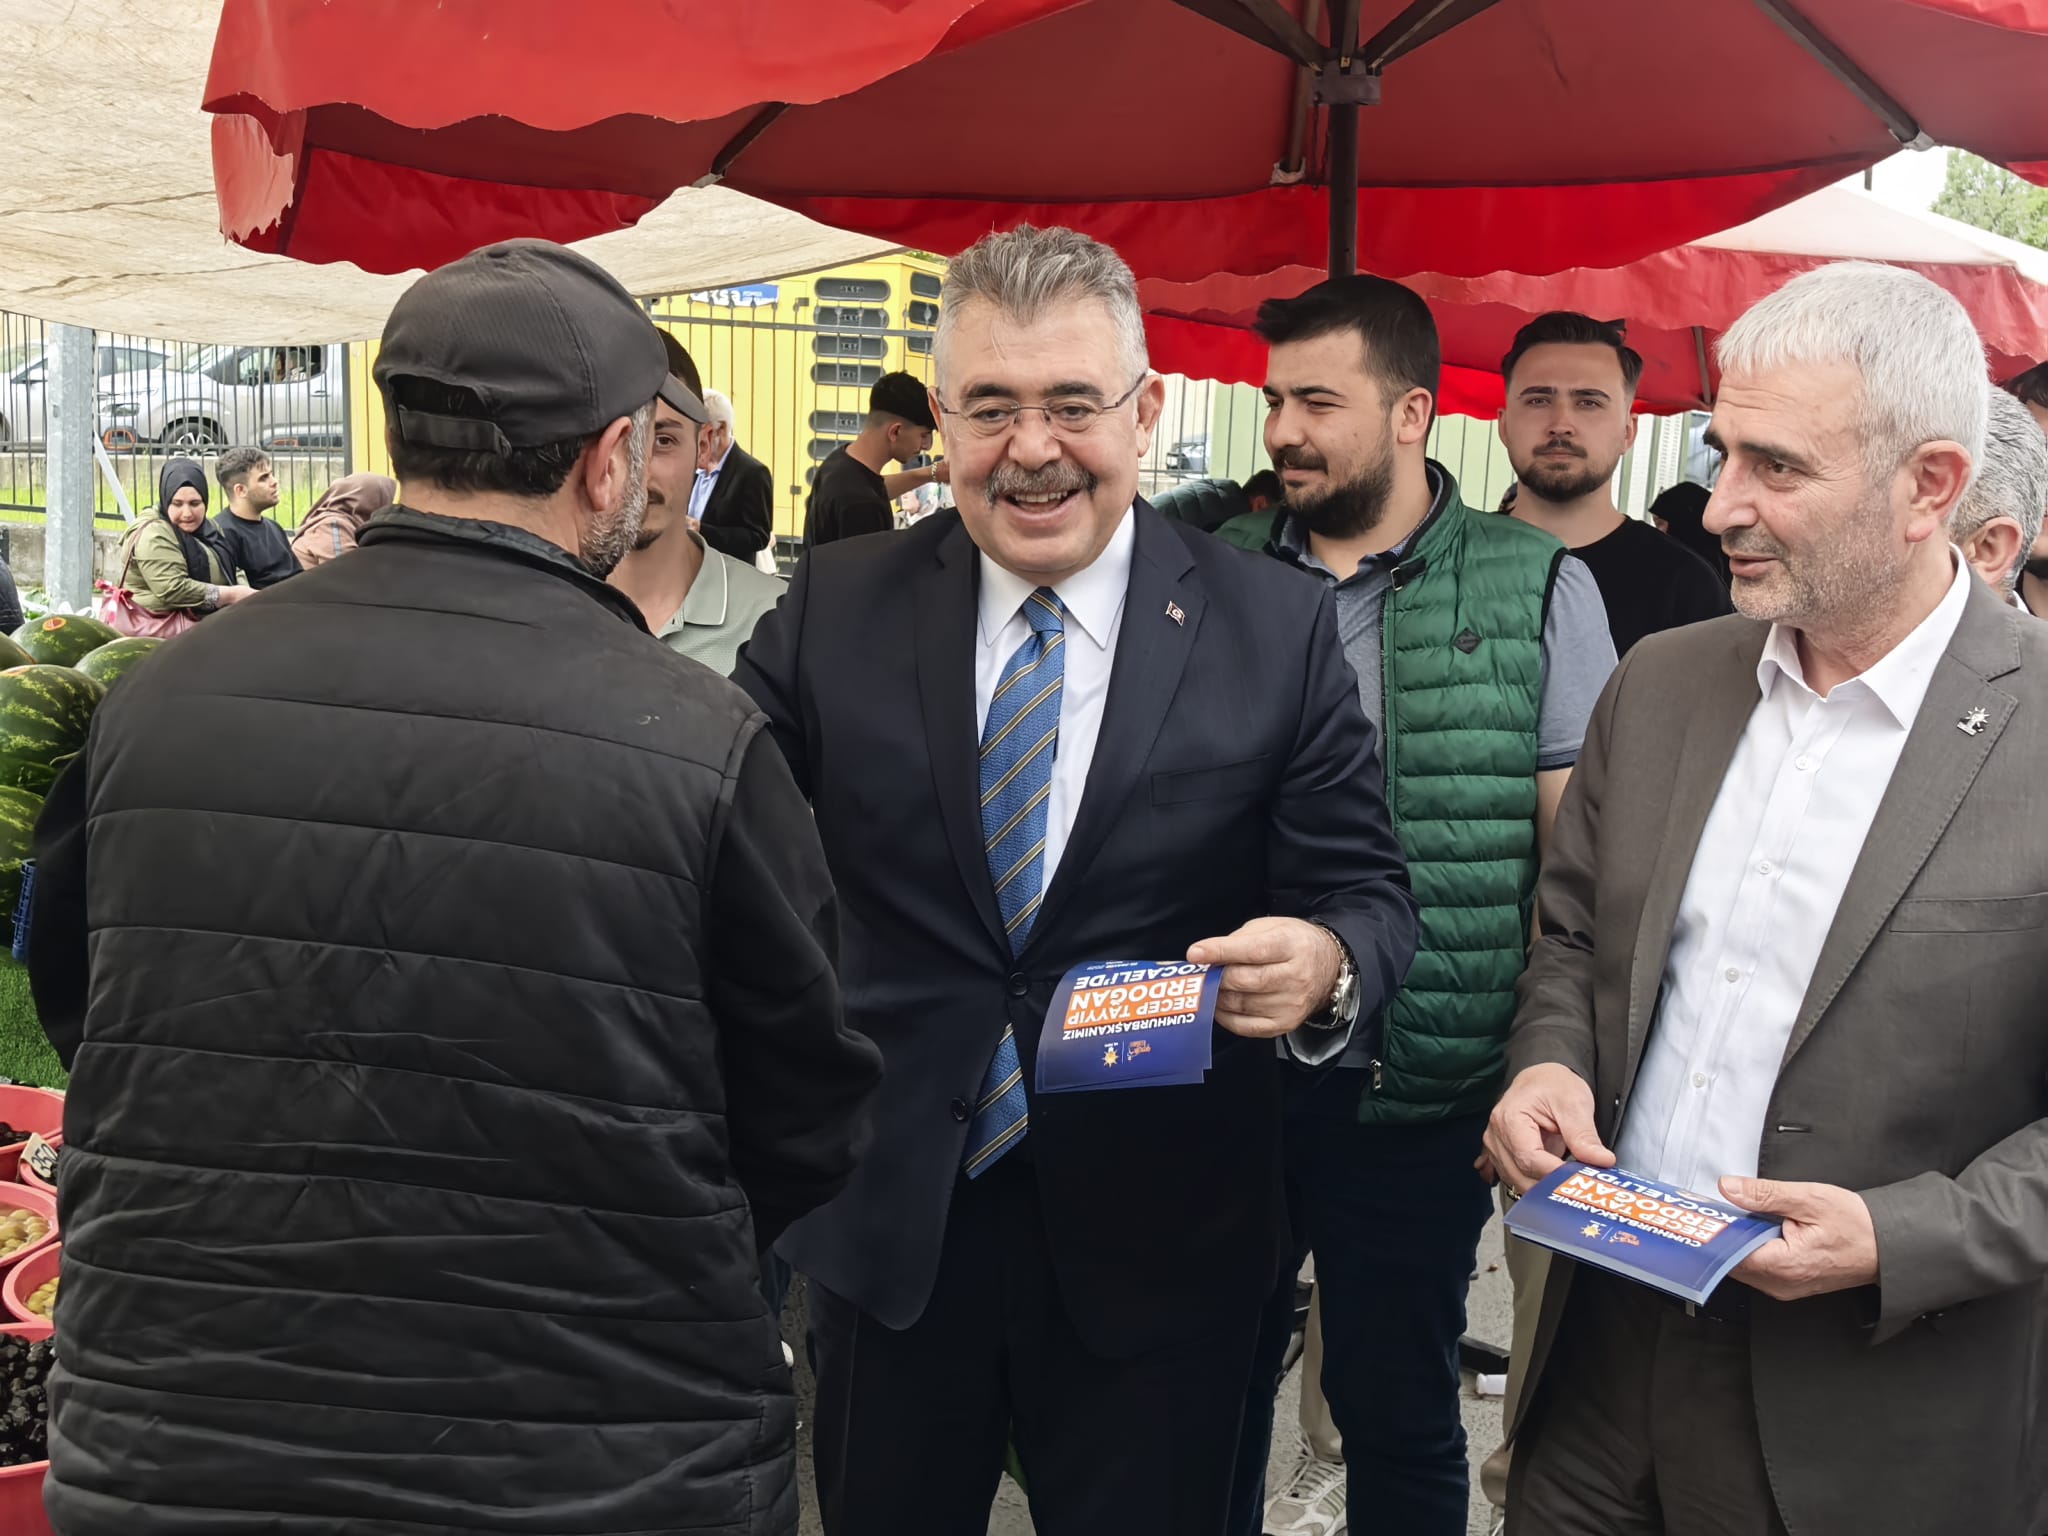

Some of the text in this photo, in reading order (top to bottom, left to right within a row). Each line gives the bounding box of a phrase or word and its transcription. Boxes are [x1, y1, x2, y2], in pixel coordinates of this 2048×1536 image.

[1071, 977, 1205, 1011] ERDOĞAN
[1136, 995, 1199, 1016] RECEP
[1062, 1012, 1196, 1041] CUMHURBAŞKANIMIZ
[1640, 1212, 1713, 1240] RECEP
